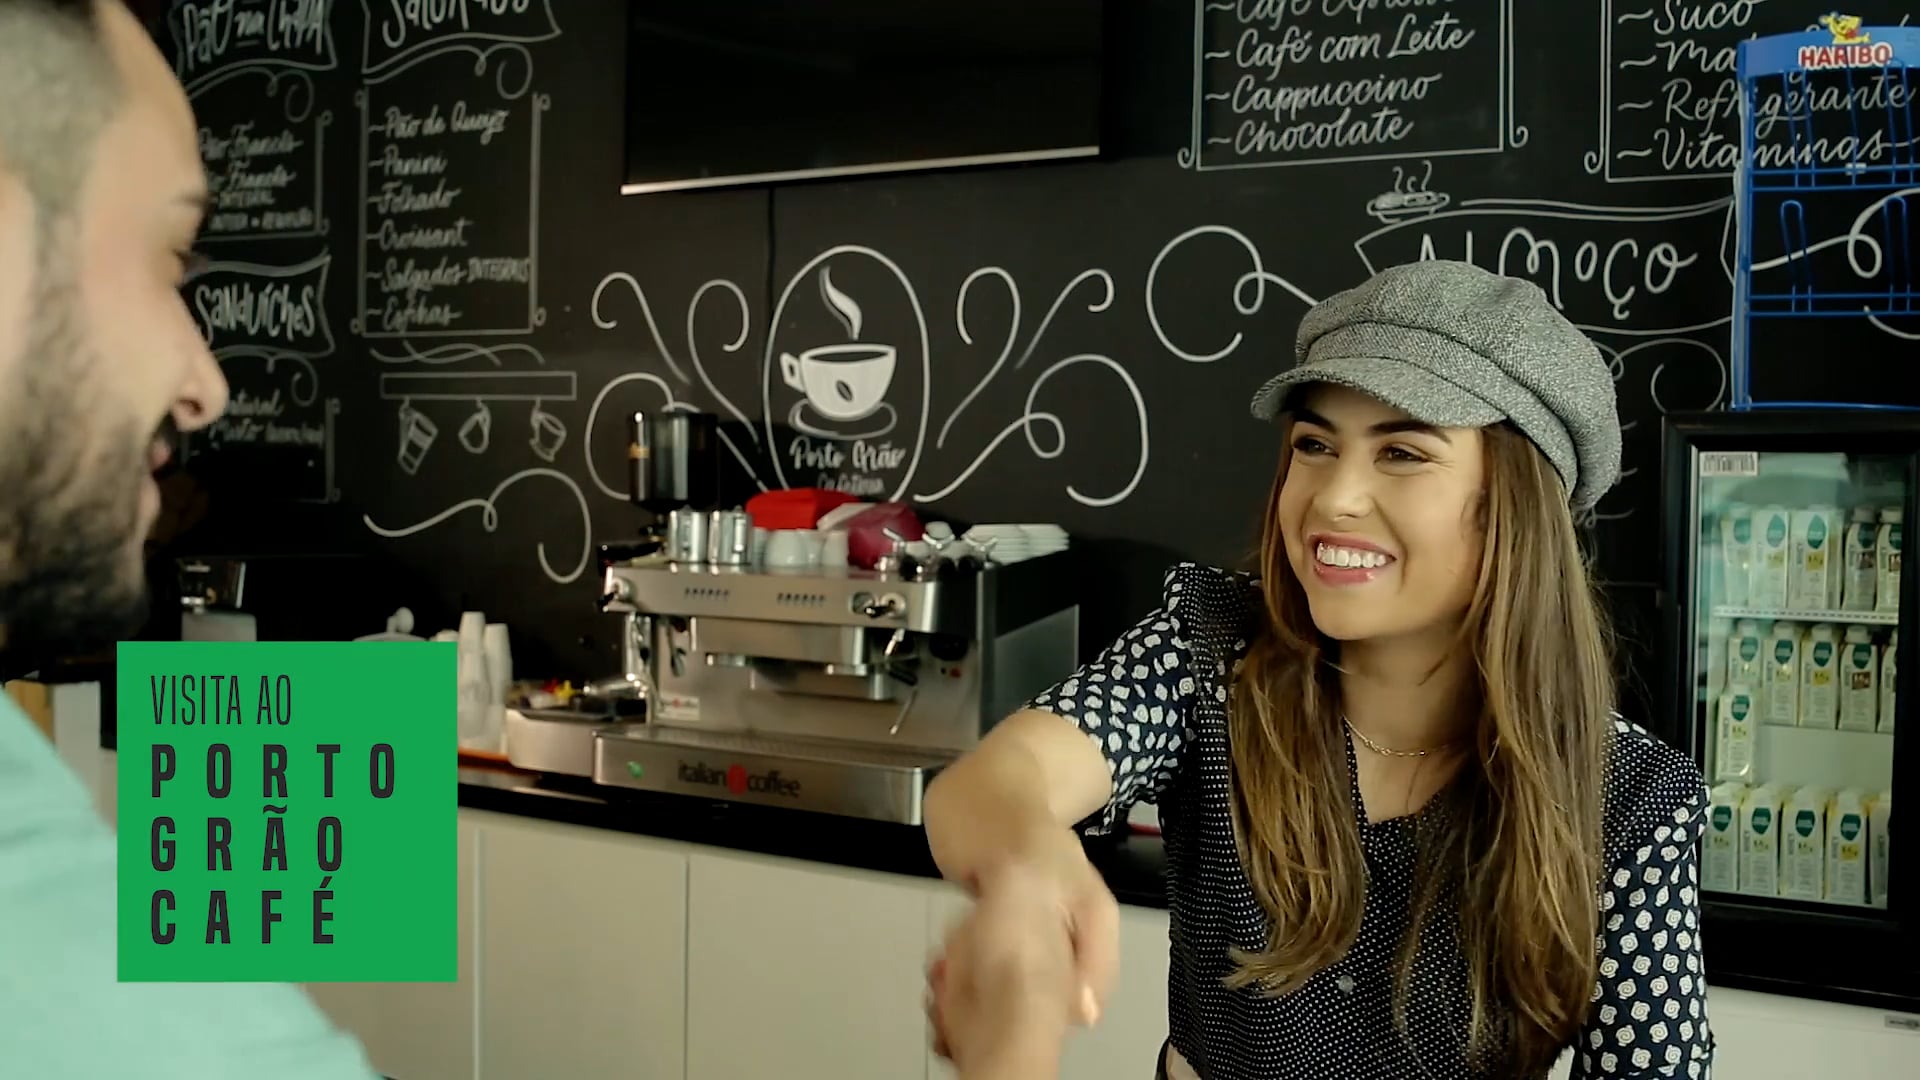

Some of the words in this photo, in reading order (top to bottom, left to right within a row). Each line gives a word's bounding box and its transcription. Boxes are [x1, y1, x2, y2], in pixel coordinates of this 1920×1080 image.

[1653, 0, 1754, 34] Suco
[1236, 25, 1315, 81] Café
[1319, 33, 1381, 63] com
[1387, 12, 1476, 59] Leite
[1799, 44, 1892, 69] HARIBO
[1231, 73, 1443, 123] Cappuccino
[385, 105, 421, 138] Pão
[422, 104, 447, 136] de
[451, 100, 511, 146] Queijo
[1234, 107, 1415, 155] Chocolate
[383, 144, 448, 176] Panini
[377, 177, 463, 214] Folhado
[379, 217, 474, 250] Croissant
[789, 435, 846, 470] Porto
[852, 439, 907, 473] Grão
